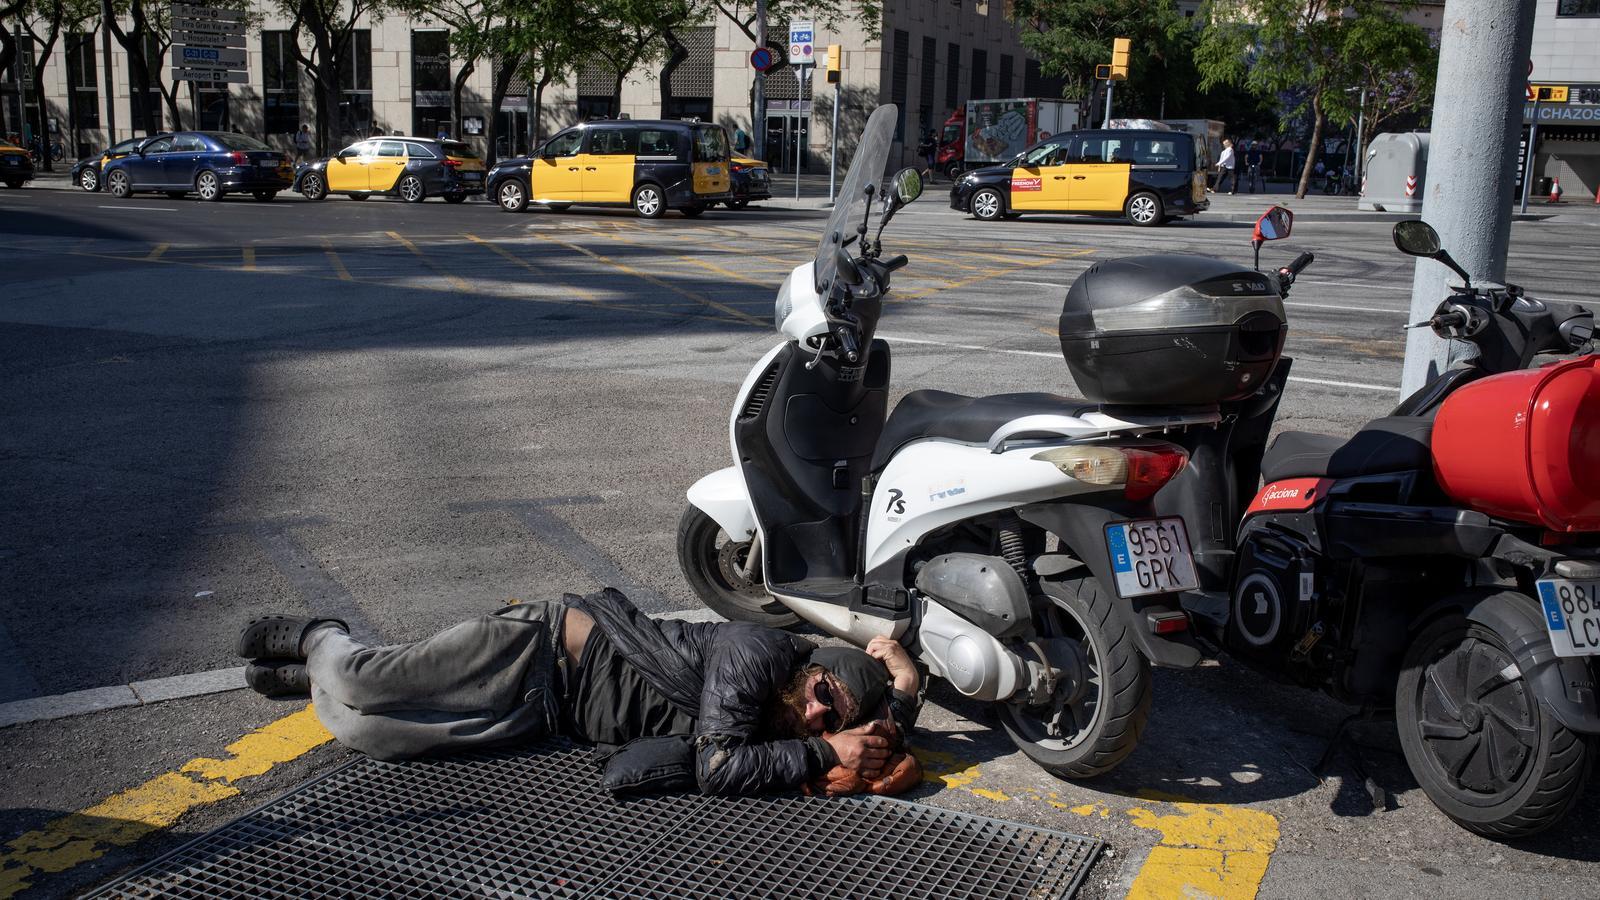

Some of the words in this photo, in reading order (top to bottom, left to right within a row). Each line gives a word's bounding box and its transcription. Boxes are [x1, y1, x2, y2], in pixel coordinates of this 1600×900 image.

[182, 20, 194, 28] Fira
[195, 22, 210, 30] Gran
[183, 71, 211, 79] Aeroport
[1523, 106, 1600, 120] ICHAZOS
[1269, 488, 1299, 500] acciona
[1128, 525, 1182, 556] 9561
[1117, 553, 1126, 565] E
[1135, 556, 1180, 588] GPK
[1550, 611, 1559, 622] E
[1566, 618, 1600, 648] LC
